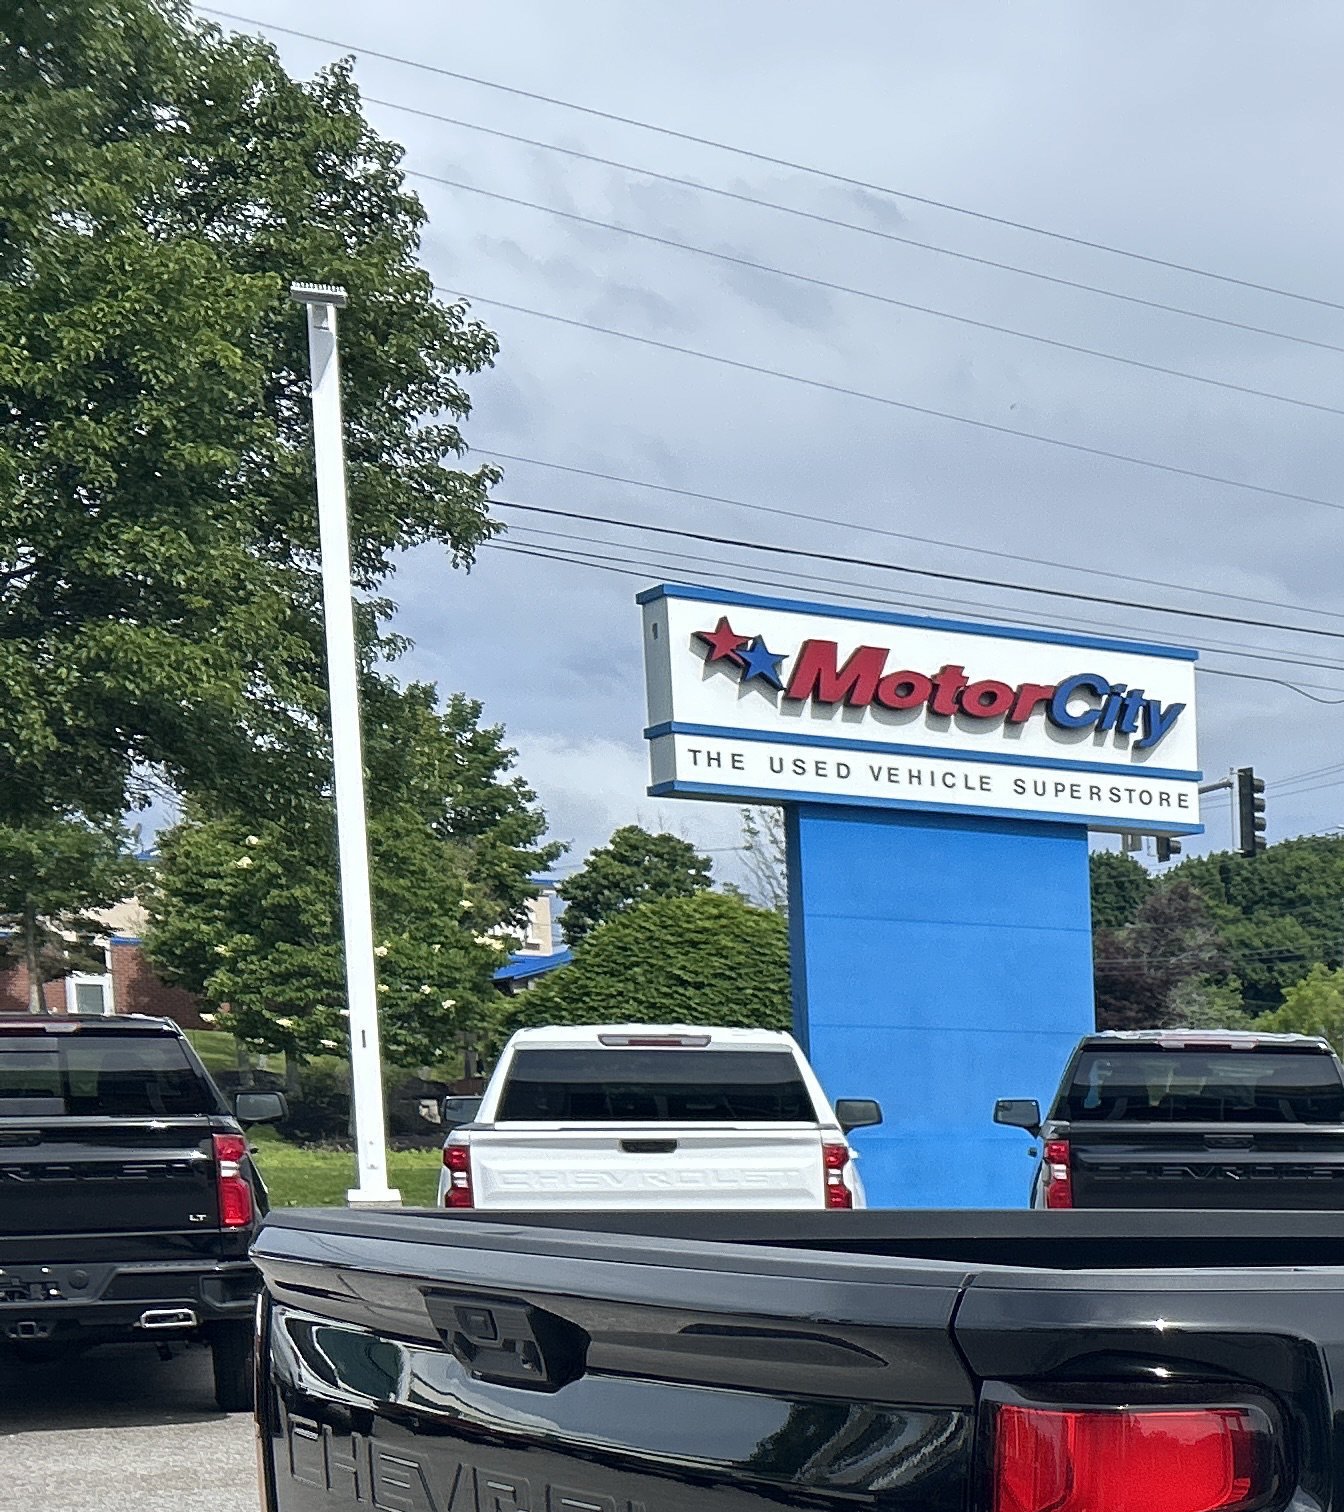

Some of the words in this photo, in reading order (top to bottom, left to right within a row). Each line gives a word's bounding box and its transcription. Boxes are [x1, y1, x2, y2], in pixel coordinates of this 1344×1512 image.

[784, 637, 1186, 749] MotorCity
[688, 748, 746, 771] THE
[769, 757, 852, 780] USED
[870, 764, 993, 793] VEHICLE
[1013, 777, 1191, 810] SUPERSTORE
[499, 1169, 801, 1190] CHEVROLET
[188, 1213, 207, 1222] LT
